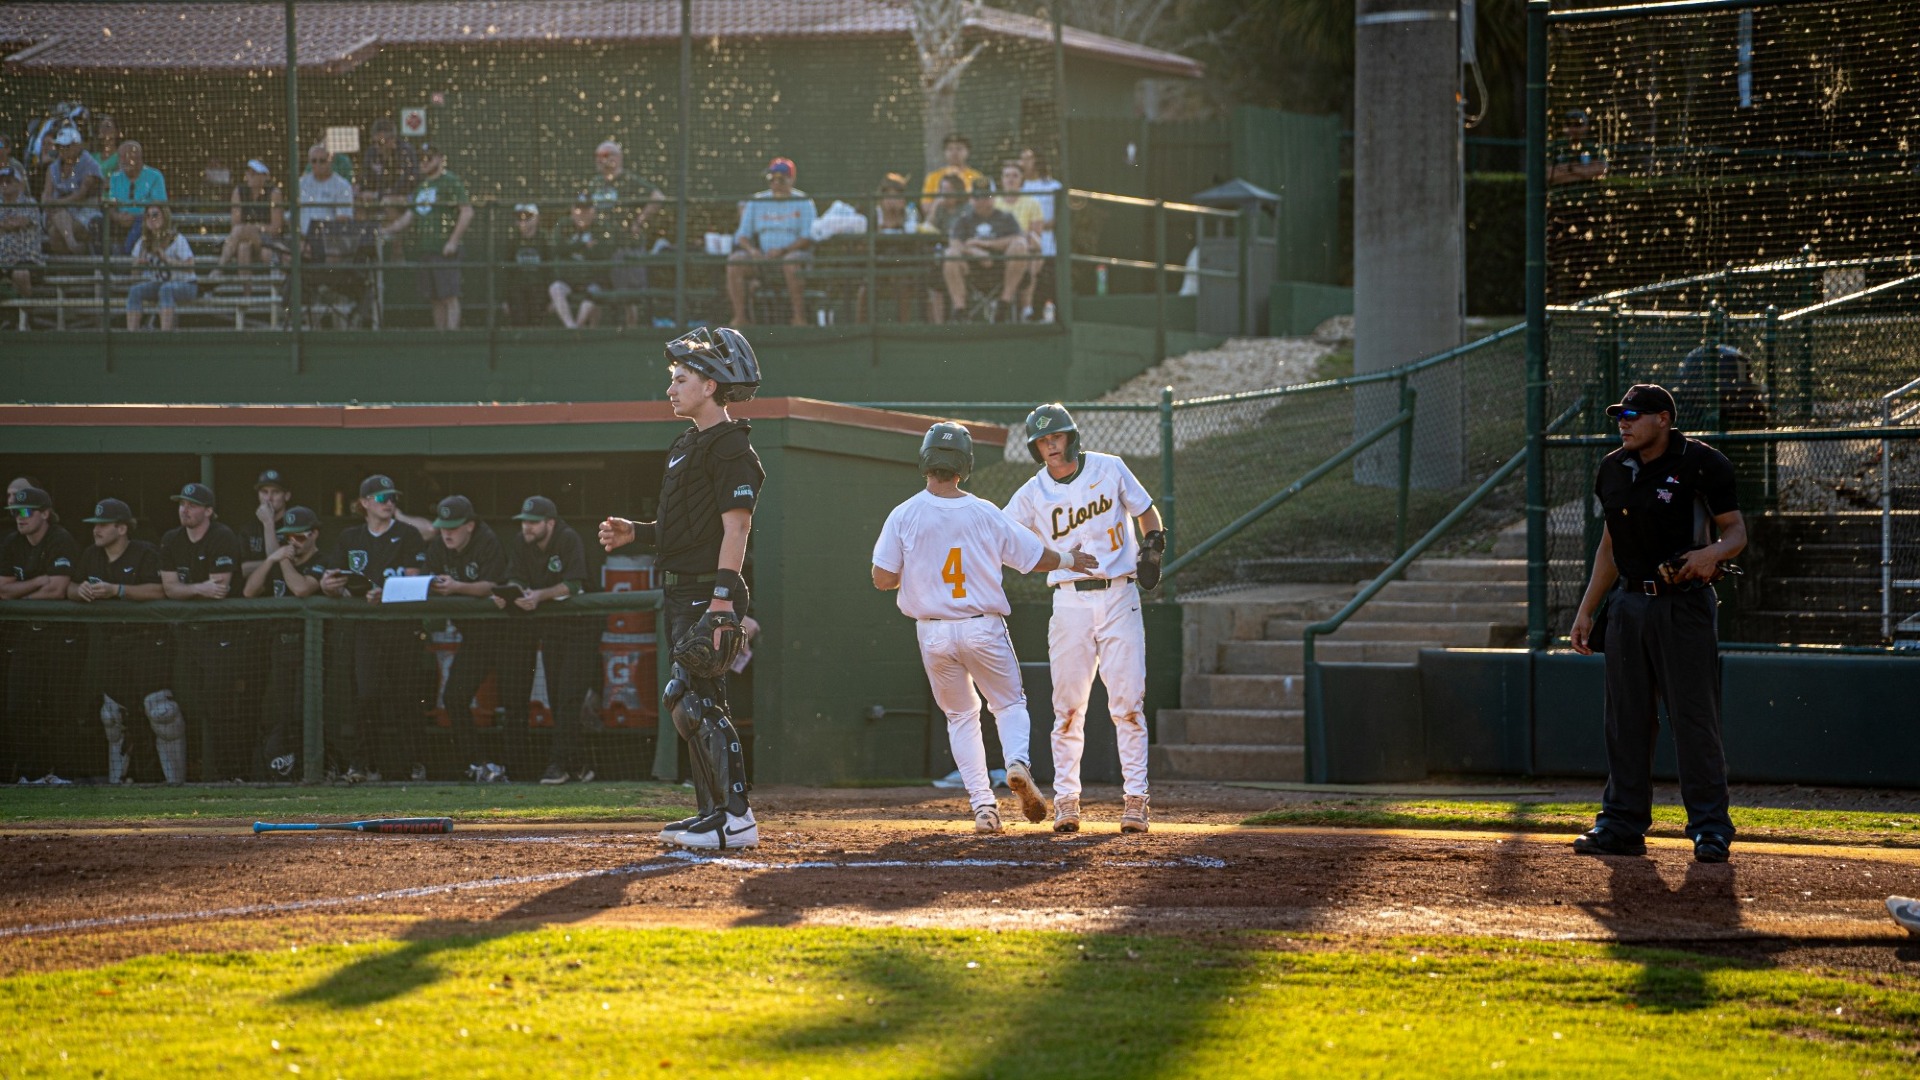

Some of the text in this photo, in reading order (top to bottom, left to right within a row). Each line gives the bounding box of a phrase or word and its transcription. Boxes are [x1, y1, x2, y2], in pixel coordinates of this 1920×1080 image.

[1051, 493, 1113, 541] Lions
[1107, 521, 1125, 552] 10
[941, 547, 967, 599] 4
[607, 655, 631, 685] G
